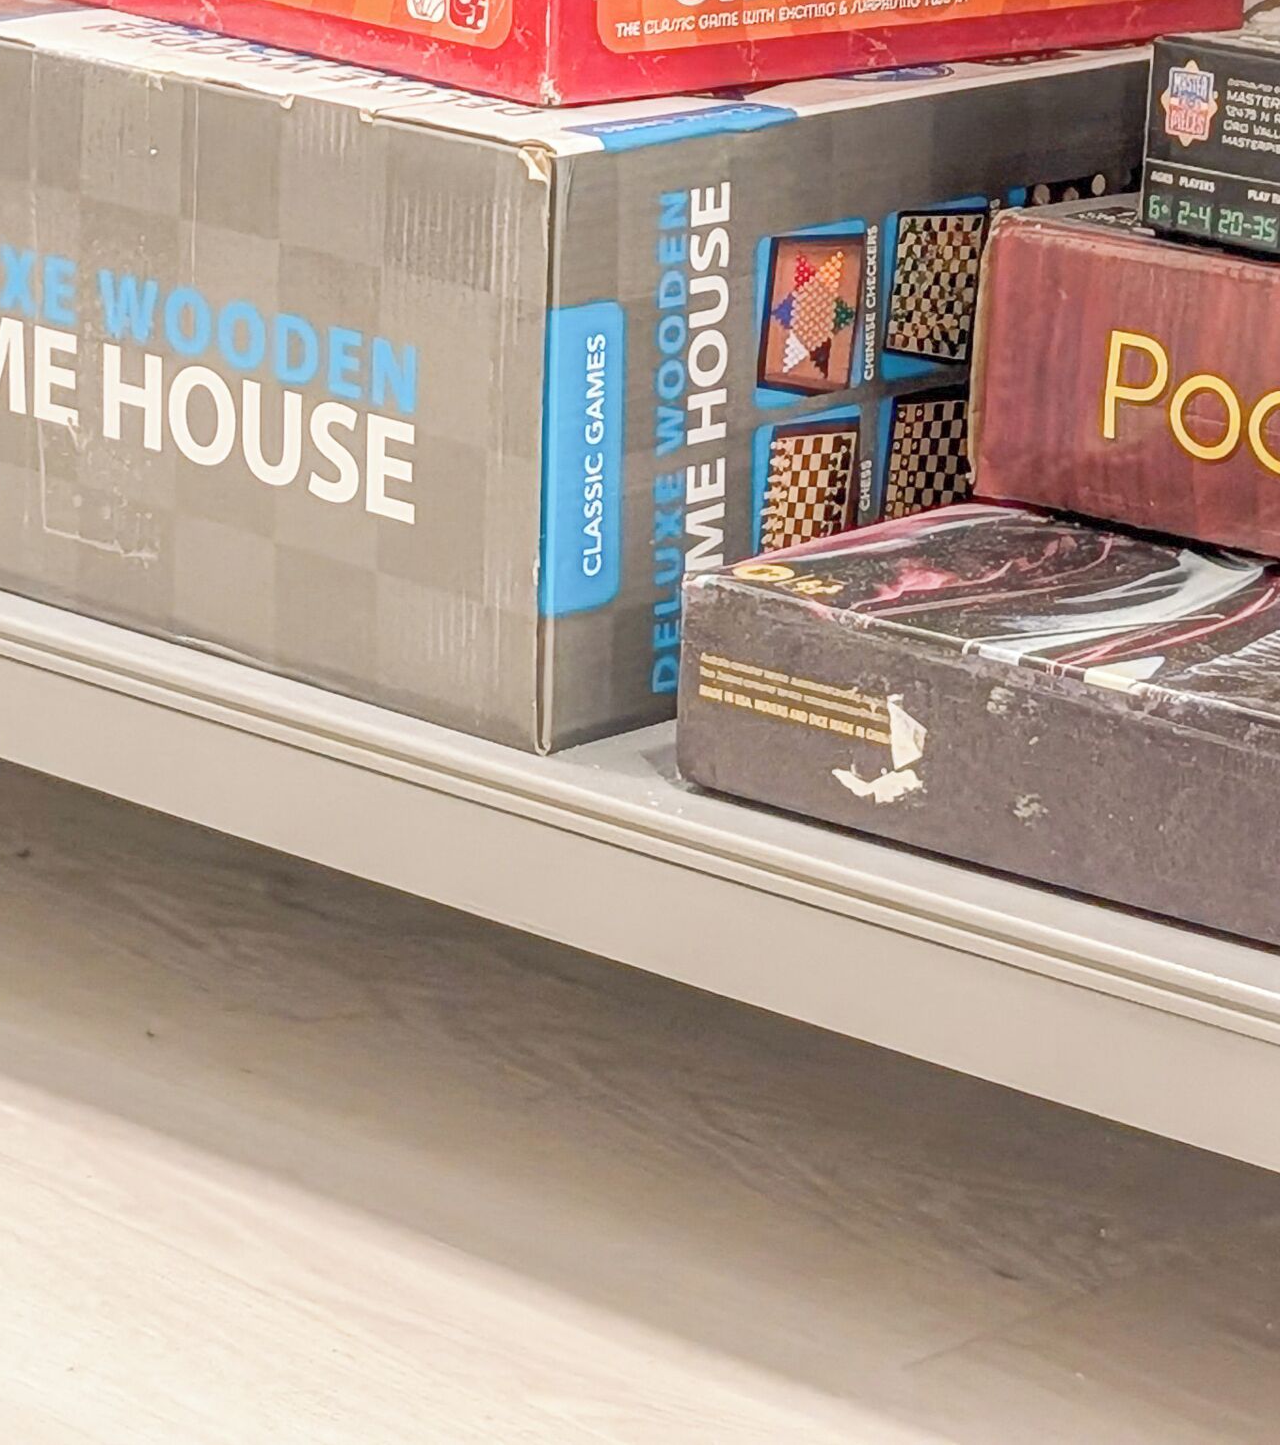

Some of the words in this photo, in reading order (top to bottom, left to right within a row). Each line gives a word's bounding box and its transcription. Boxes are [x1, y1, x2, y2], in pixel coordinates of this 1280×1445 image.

[615, 20, 641, 38] THE
[698, 11, 738, 30] GAME
[742, 7, 775, 26] WITH
[778, 1, 837, 22] EXCITING
[839, 1, 848, 15] &
[1223, 120, 1249, 134] ORO
[1260, 112, 1270, 124] N
[1177, 200, 1212, 229] 2-4
[1217, 208, 1278, 243] 20-35
[1178, 175, 1216, 194] PLAYERS
[686, 180, 733, 447] HOUSE
[865, 224, 880, 310] CHECKERS
[97, 267, 420, 415] WOODEN
[653, 186, 690, 457] WOODEN
[863, 311, 877, 382] CHINESE
[102, 343, 417, 526] HOUSE
[584, 332, 607, 448] GAMES
[582, 450, 606, 579] CLASSIC
[685, 456, 727, 572] ME
[859, 458, 873, 513] CHESS
[651, 468, 686, 694] DELUXE
